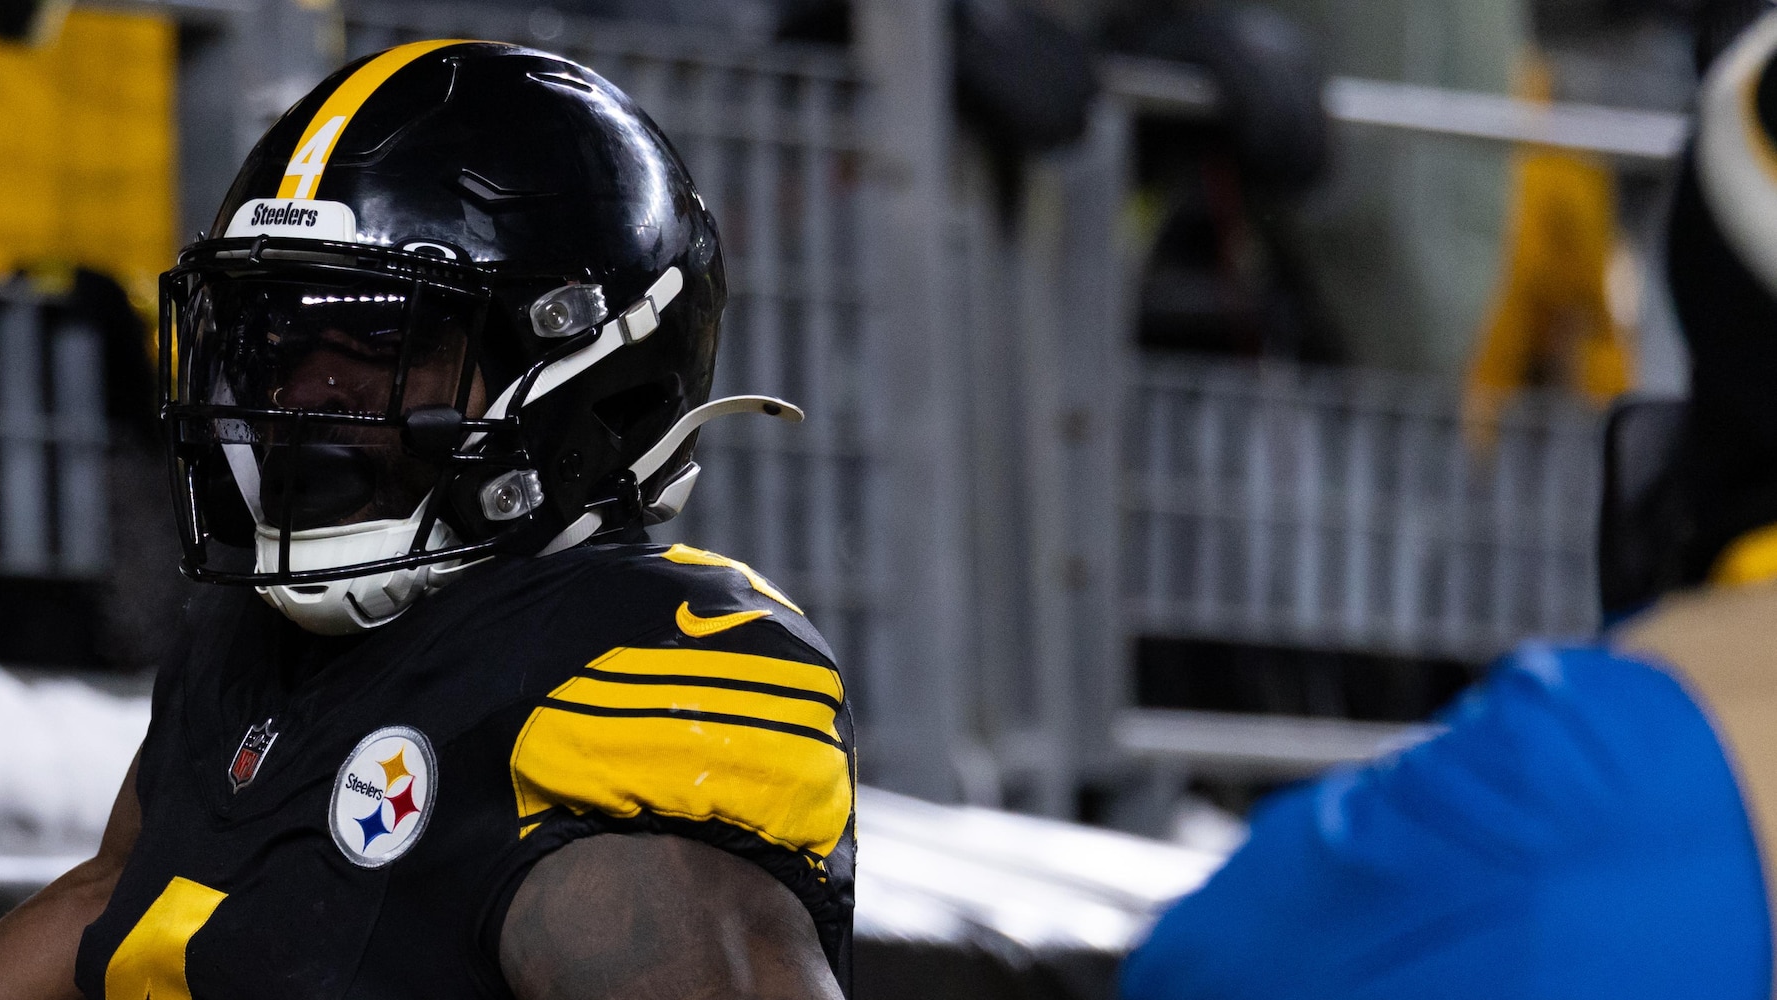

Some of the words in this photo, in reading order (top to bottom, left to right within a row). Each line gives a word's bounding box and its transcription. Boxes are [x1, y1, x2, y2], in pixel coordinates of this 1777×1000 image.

[285, 116, 347, 198] 4
[251, 202, 318, 227] Steelers
[345, 772, 384, 802] Steelers
